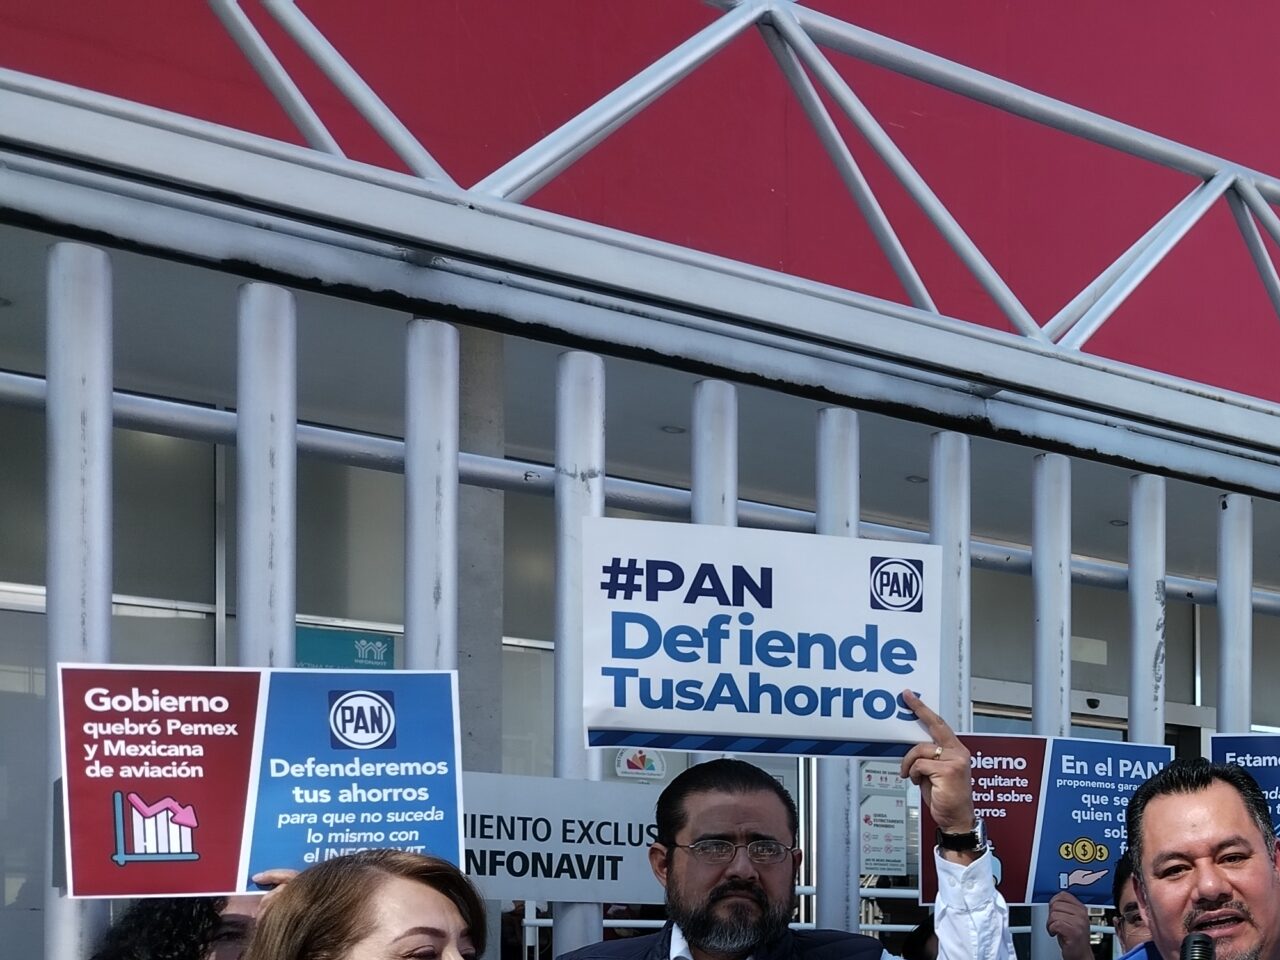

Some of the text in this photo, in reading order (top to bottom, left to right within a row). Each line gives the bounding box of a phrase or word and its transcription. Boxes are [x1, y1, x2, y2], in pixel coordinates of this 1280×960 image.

[600, 557, 773, 609] #PAN
[879, 570, 914, 599] PAN
[611, 610, 918, 675] Defiende
[84, 687, 229, 713] Gobierno
[601, 666, 921, 721] TusAhorros
[83, 717, 238, 739] quebró Pemex
[340, 706, 384, 734] PAN
[83, 740, 204, 761] y Mexicana
[85, 760, 204, 778] de aviación
[269, 757, 449, 778] Defenderemos
[1061, 755, 1088, 775] En
[1094, 757, 1112, 777] el
[978, 775, 1029, 789] quitarte
[1056, 778, 1115, 790] proponemos
[292, 783, 429, 803] tus ahorros
[972, 790, 1033, 803] trol sobre
[1081, 794, 1109, 808] que
[277, 806, 444, 828] para que no suceda
[973, 806, 1007, 818] orros
[1072, 808, 1112, 823] quien
[307, 828, 420, 844] lo mismo con
[562, 819, 660, 847] EXCLUS
[1104, 828, 1128, 839] sob
[303, 848, 319, 863] el
[465, 849, 624, 881] NFONAVIT
